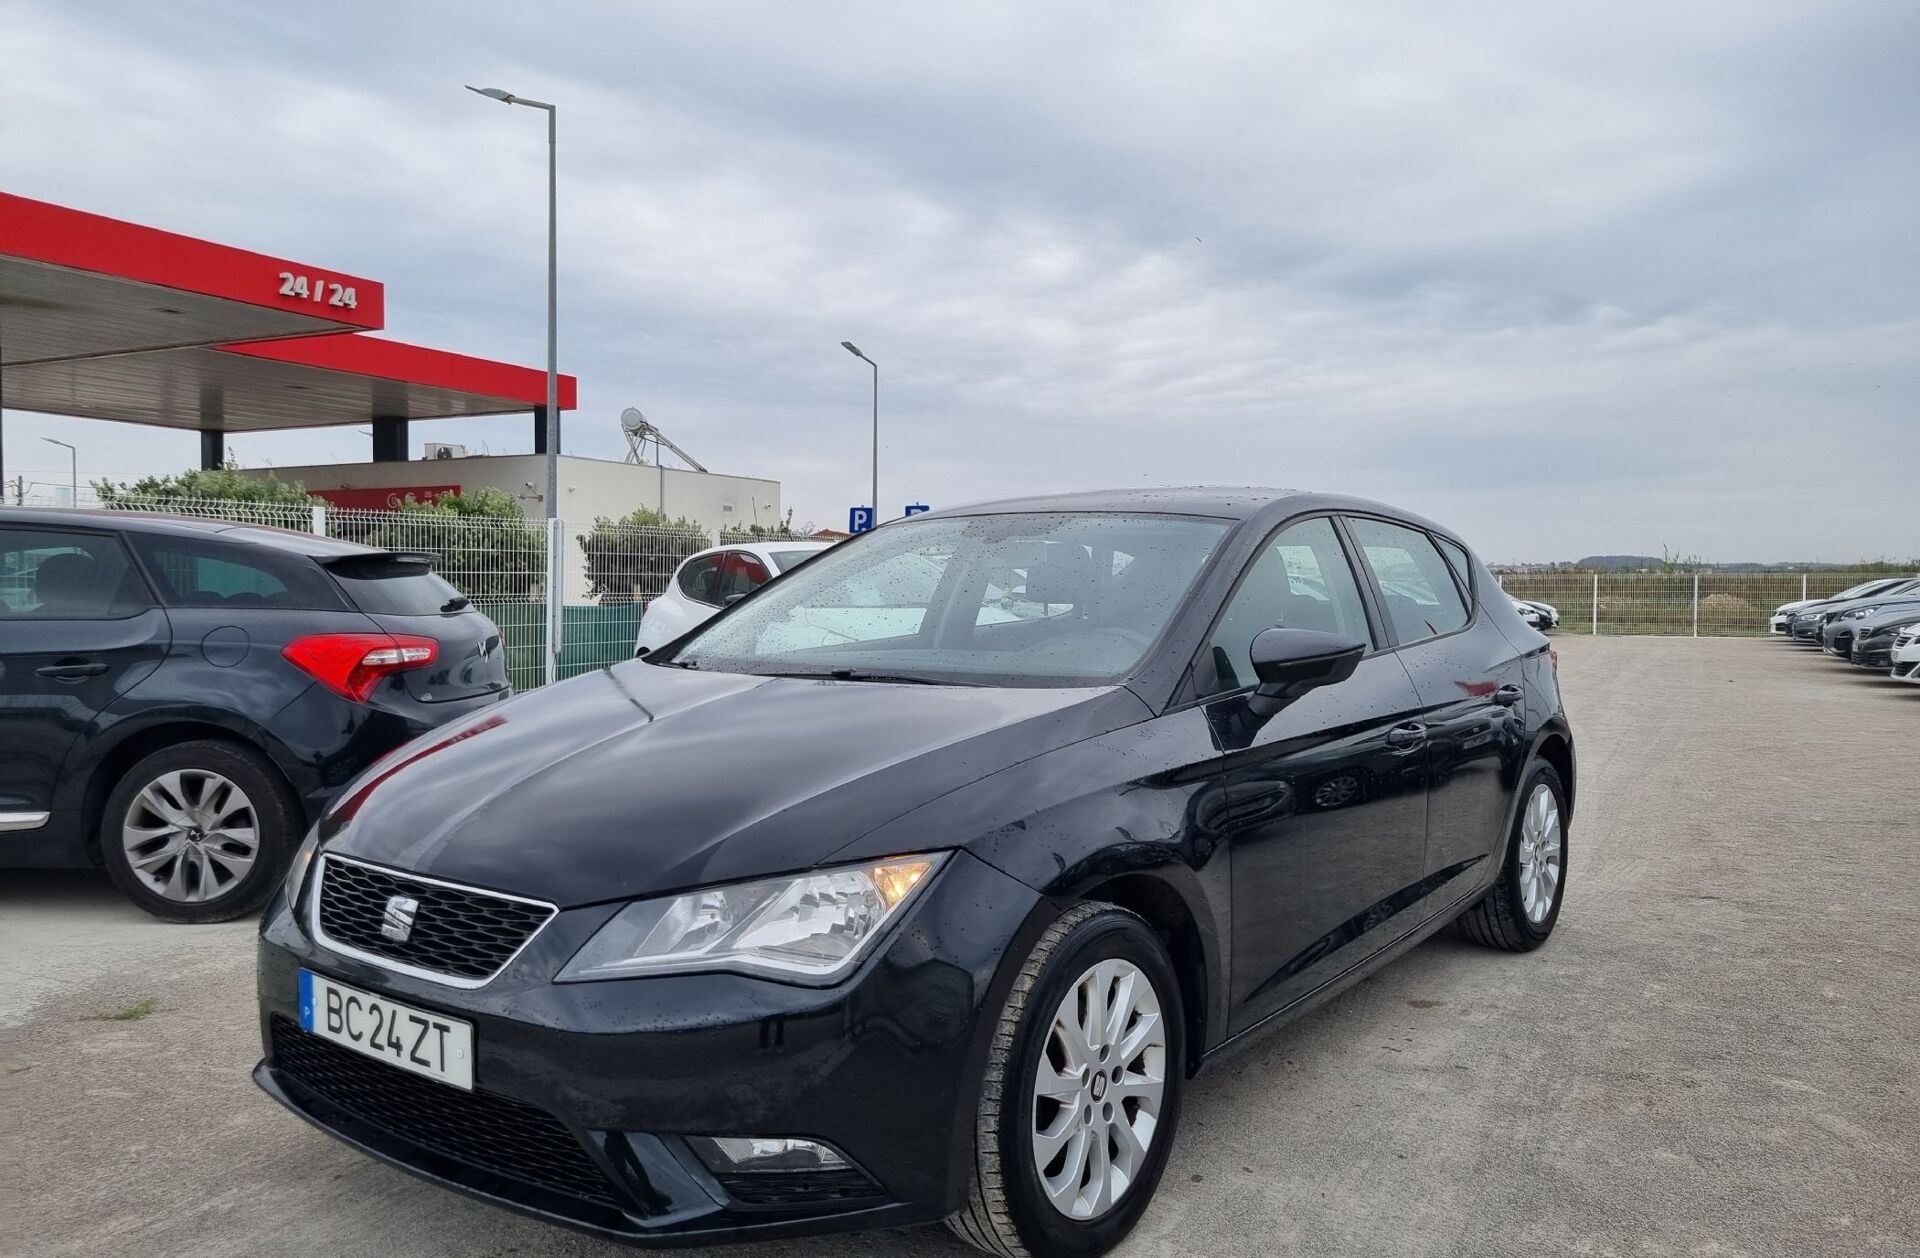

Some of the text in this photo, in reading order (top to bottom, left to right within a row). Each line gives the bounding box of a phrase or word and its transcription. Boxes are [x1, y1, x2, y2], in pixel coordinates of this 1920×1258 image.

[279, 272, 309, 298] 24
[329, 283, 357, 309] 24
[854, 510, 867, 531] P
